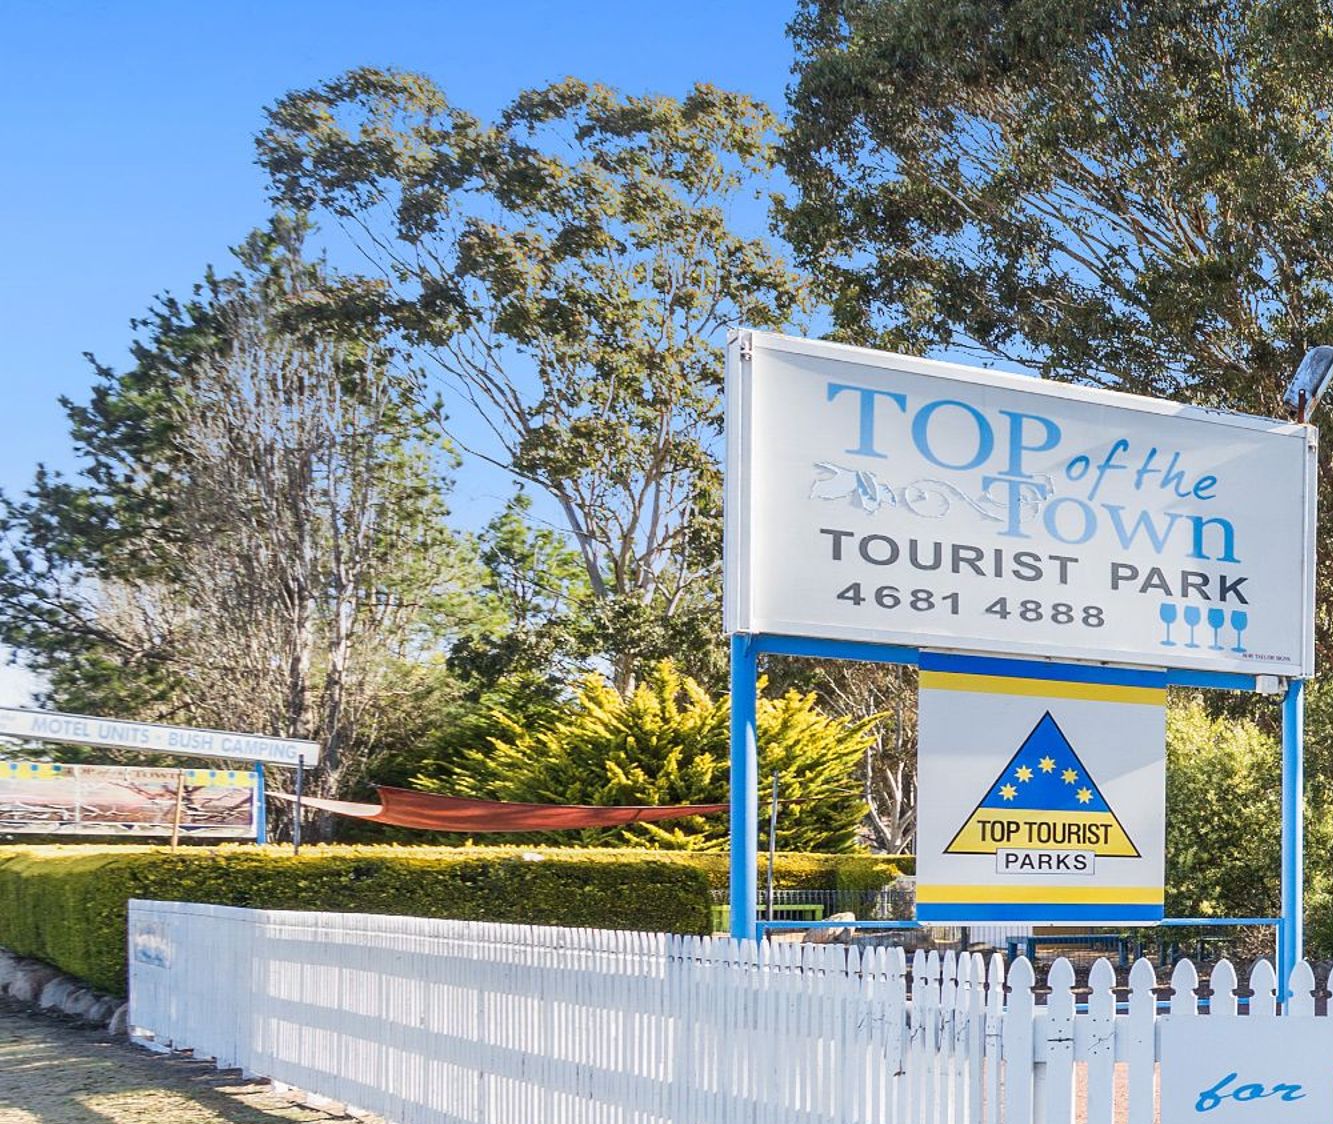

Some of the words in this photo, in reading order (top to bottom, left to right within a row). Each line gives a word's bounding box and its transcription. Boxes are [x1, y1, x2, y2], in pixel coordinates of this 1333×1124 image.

[827, 382, 1062, 479] TOP
[1065, 438, 1129, 501] of
[1134, 447, 1218, 500] the
[981, 475, 1241, 563] Town
[819, 528, 1079, 585] TOURIST
[1110, 561, 1250, 604] PARK
[836, 581, 961, 616] 4681
[985, 595, 1106, 629] 4888
[32, 717, 91, 738] MOTEL
[98, 727, 150, 744] UNITS
[168, 732, 213, 750] BUSH
[221, 737, 298, 760] CAMPING
[977, 820, 1021, 843] TOP
[1024, 821, 1113, 845] TOURIST
[1004, 852, 1088, 871] PARKS
[1195, 1072, 1307, 1113] for
